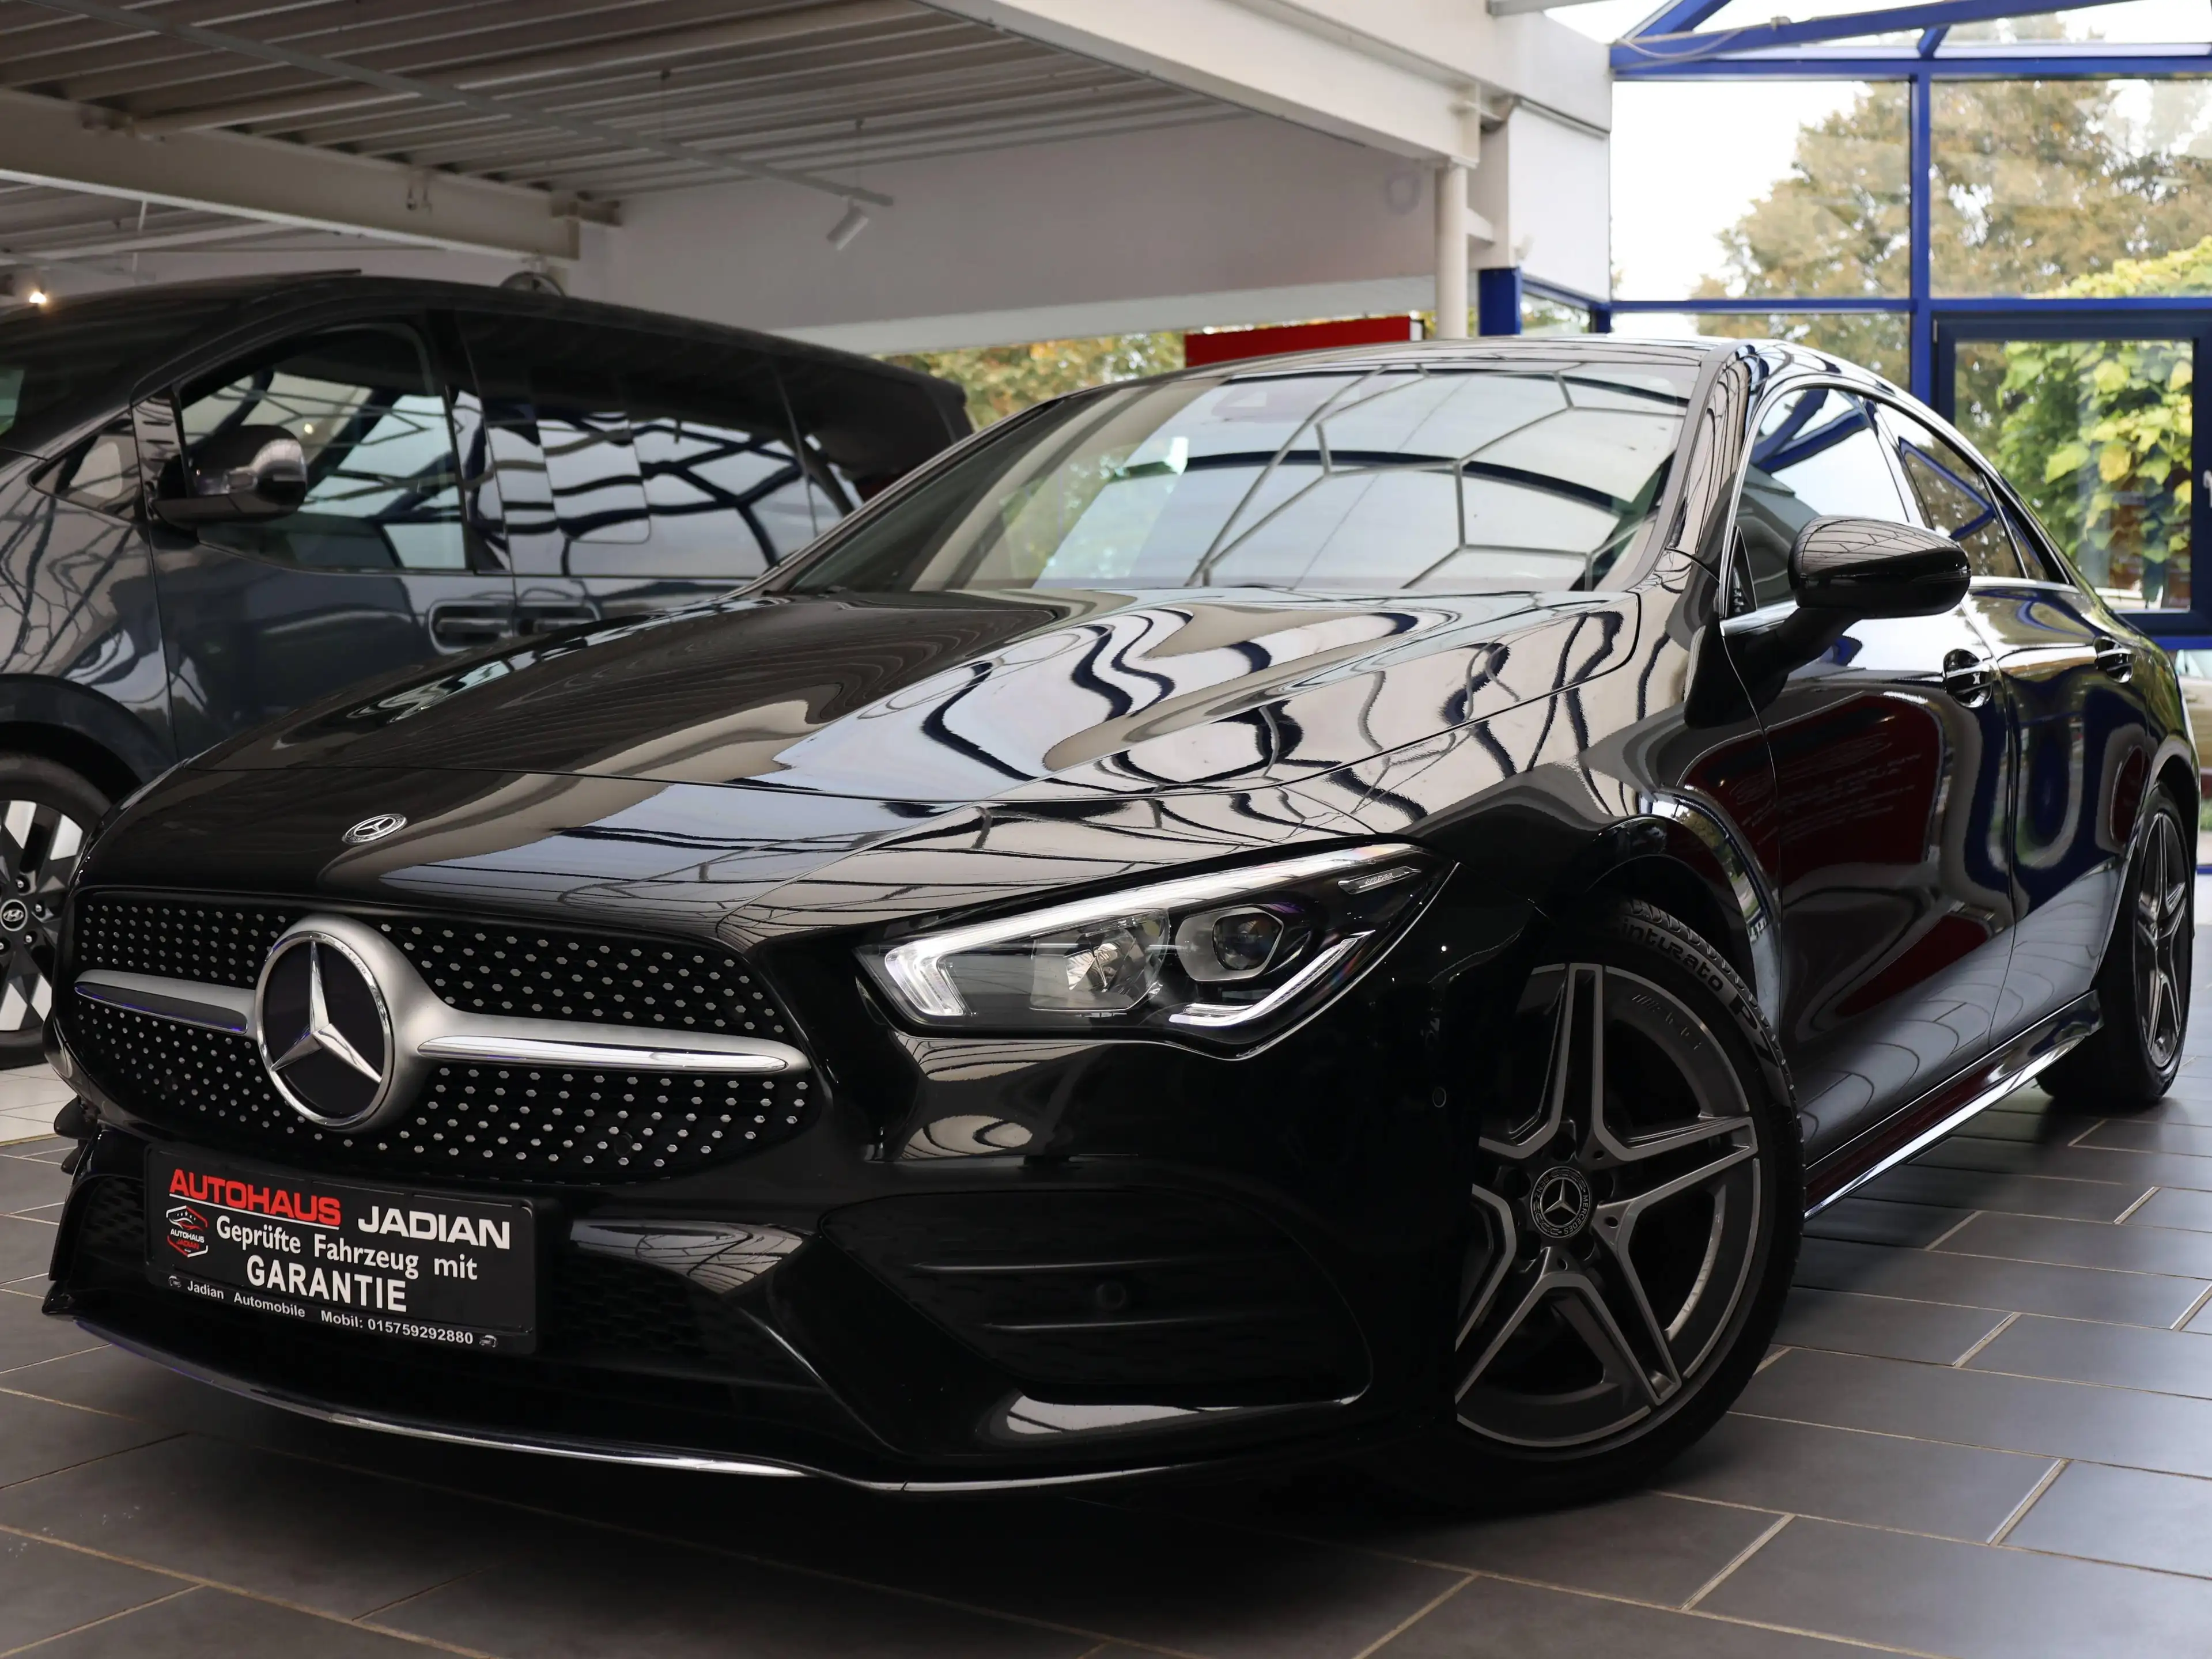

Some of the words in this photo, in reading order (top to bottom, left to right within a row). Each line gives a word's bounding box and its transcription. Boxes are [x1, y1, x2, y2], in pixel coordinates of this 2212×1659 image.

[1618, 917, 1724, 992] inturato
[169, 1169, 341, 1226] AUTOHAUS
[358, 1206, 510, 1249] JADIAN
[1534, 1175, 1550, 1199] BENZ
[1564, 1194, 1589, 1234] MERCEDES
[170, 1228, 205, 1244] AUTOHAUS
[217, 1215, 301, 1253] Geprüfte
[315, 1233, 419, 1279] Fahrzeug
[434, 1254, 478, 1280] mit
[187, 1281, 224, 1300] Jadian
[233, 1293, 305, 1317] Automobile
[321, 1310, 364, 1328] Mobil:
[368, 1318, 473, 1344] 015759292880
[247, 1255, 407, 1312] GARANTIE
